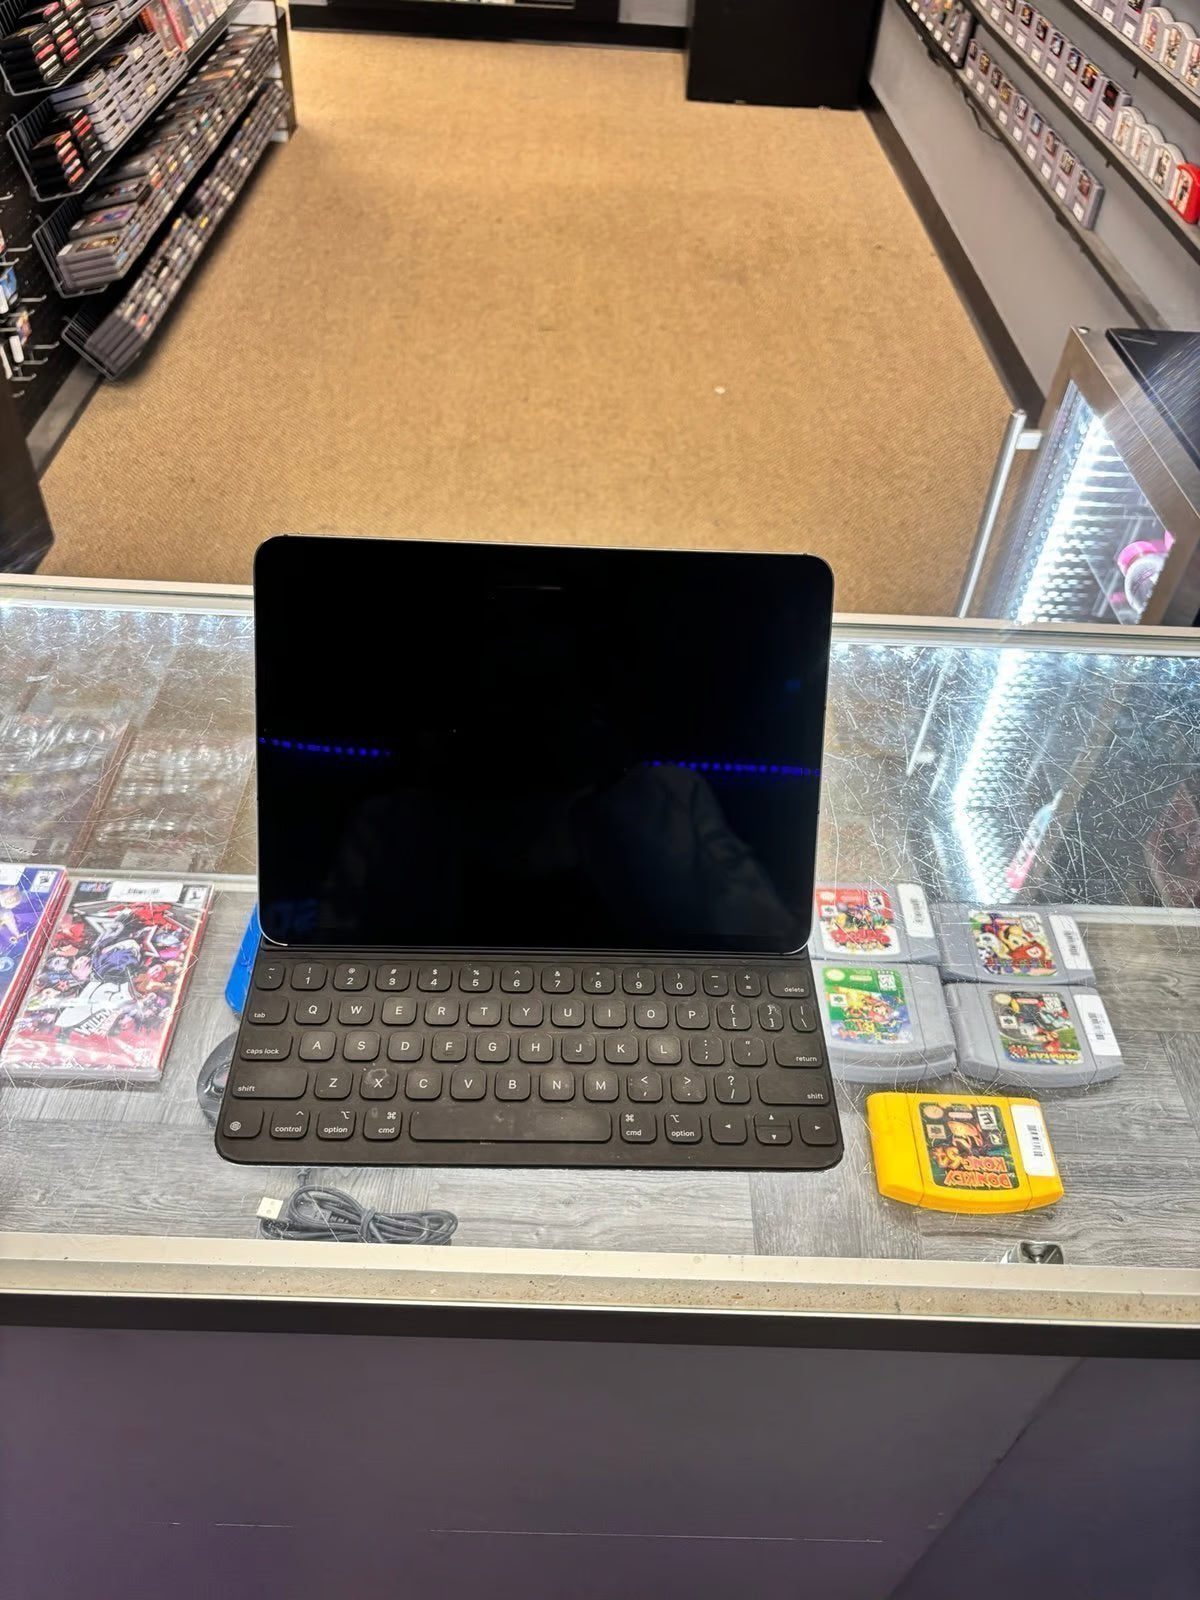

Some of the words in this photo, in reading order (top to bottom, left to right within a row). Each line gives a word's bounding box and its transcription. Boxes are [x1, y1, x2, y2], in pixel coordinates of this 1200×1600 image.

[305, 976, 310, 985] 1
[346, 977, 354, 985] 2
[388, 977, 396, 986] 3
[430, 978, 438, 986] 4
[472, 978, 479, 987] 5
[513, 979, 521, 988] 6
[554, 979, 561, 988] 7
[594, 980, 602, 989] 8
[635, 981, 643, 990] 9
[675, 982, 683, 990] 0
[308, 1004, 318, 1015] Q
[350, 1005, 363, 1015] W
[395, 1005, 403, 1015] E
[437, 1006, 446, 1016] R
[480, 1006, 489, 1016] T
[522, 1007, 531, 1017] Y
[563, 1008, 572, 1018] U
[608, 1008, 611, 1018] I
[646, 1009, 656, 1019] O
[688, 1010, 697, 1020] P
[312, 1040, 322, 1050] A
[357, 1040, 366, 1051] S
[400, 1041, 410, 1051] D
[445, 1041, 453, 1051] F
[488, 1042, 497, 1052] G
[531, 1042, 541, 1052] H
[575, 1043, 582, 1053] J
[617, 1043, 625, 1053] K
[660, 1044, 668, 1054] L
[328, 1077, 338, 1088] Z
[373, 1078, 384, 1088] X
[418, 1078, 429, 1089] C
[464, 1079, 473, 1089] V
[508, 1079, 517, 1090] B
[552, 1079, 562, 1090] N
[595, 1080, 606, 1090] M
[274, 1125, 302, 1133] control
[323, 1126, 348, 1134] option
[377, 1126, 395, 1134] cmd
[671, 1130, 695, 1138] option
[931, 1146, 963, 1169] 64
[961, 1155, 1007, 1173] KONG
[943, 1169, 1013, 1189] DONKEY
